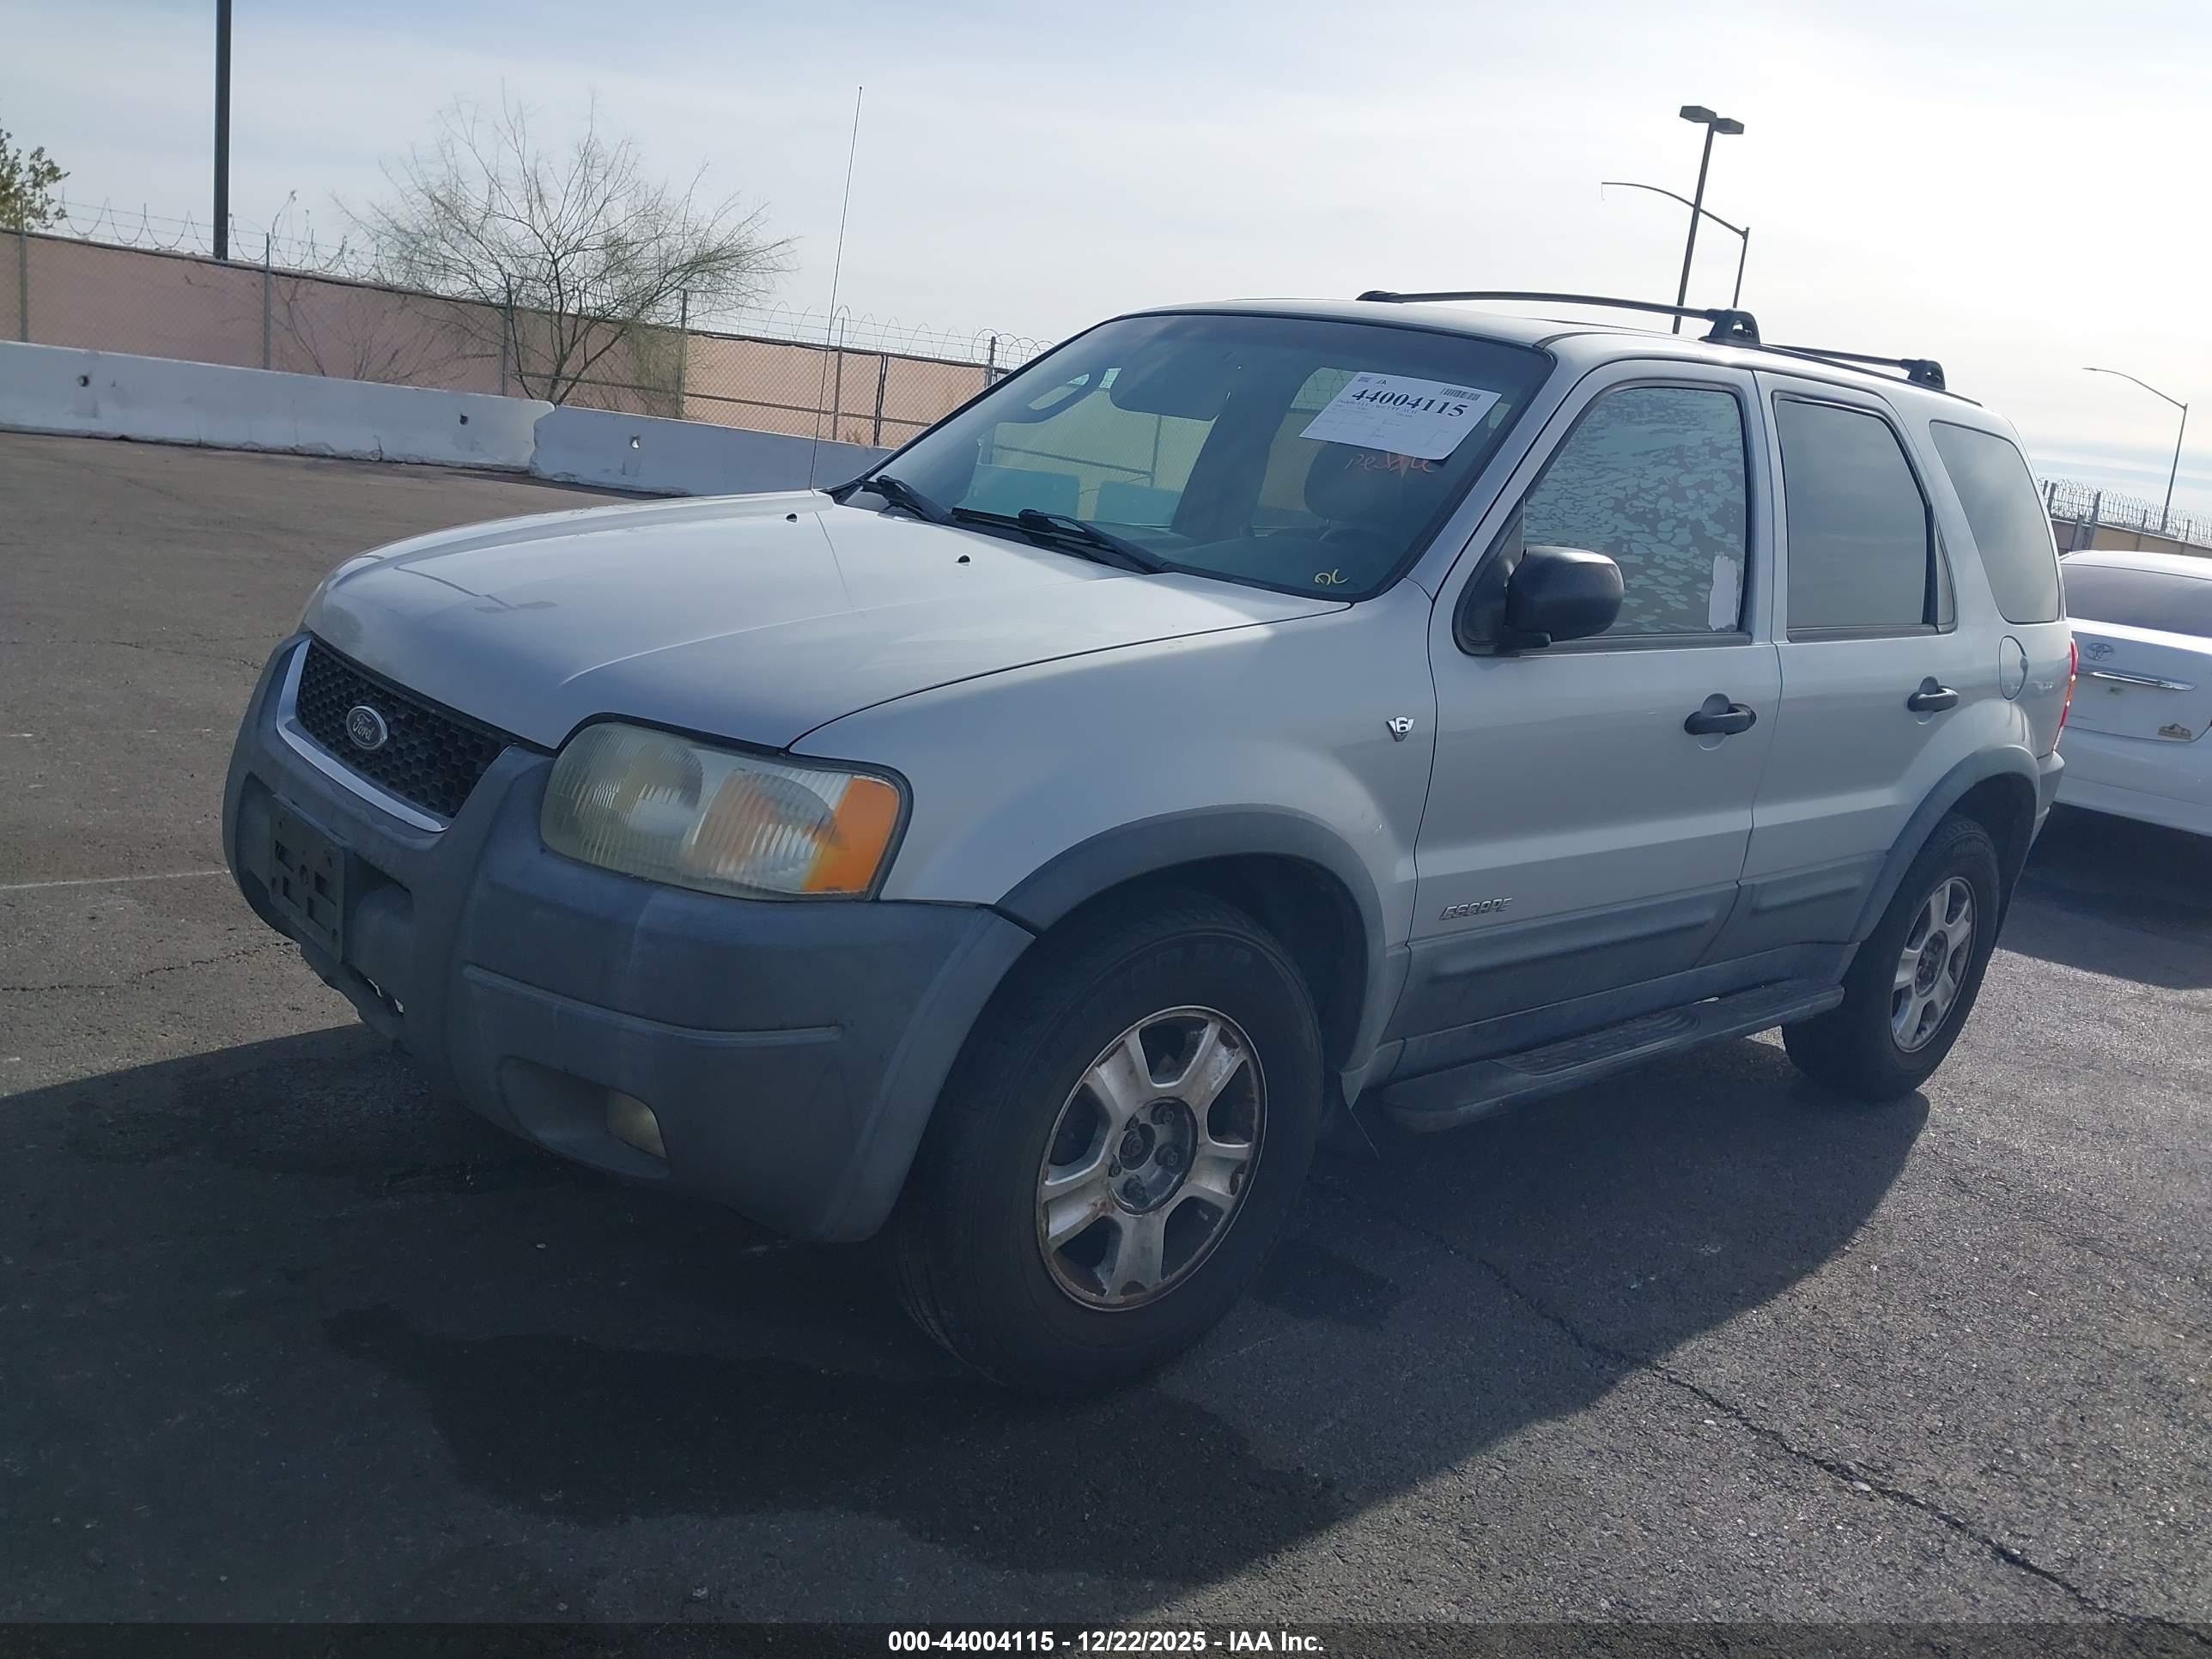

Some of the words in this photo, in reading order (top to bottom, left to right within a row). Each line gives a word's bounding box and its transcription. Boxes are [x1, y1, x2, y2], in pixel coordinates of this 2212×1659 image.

[1351, 388, 1469, 418] 44004115
[352, 713, 376, 741] Ford
[1385, 716, 1415, 743] V6
[1438, 896, 1513, 921] ESCAPE
